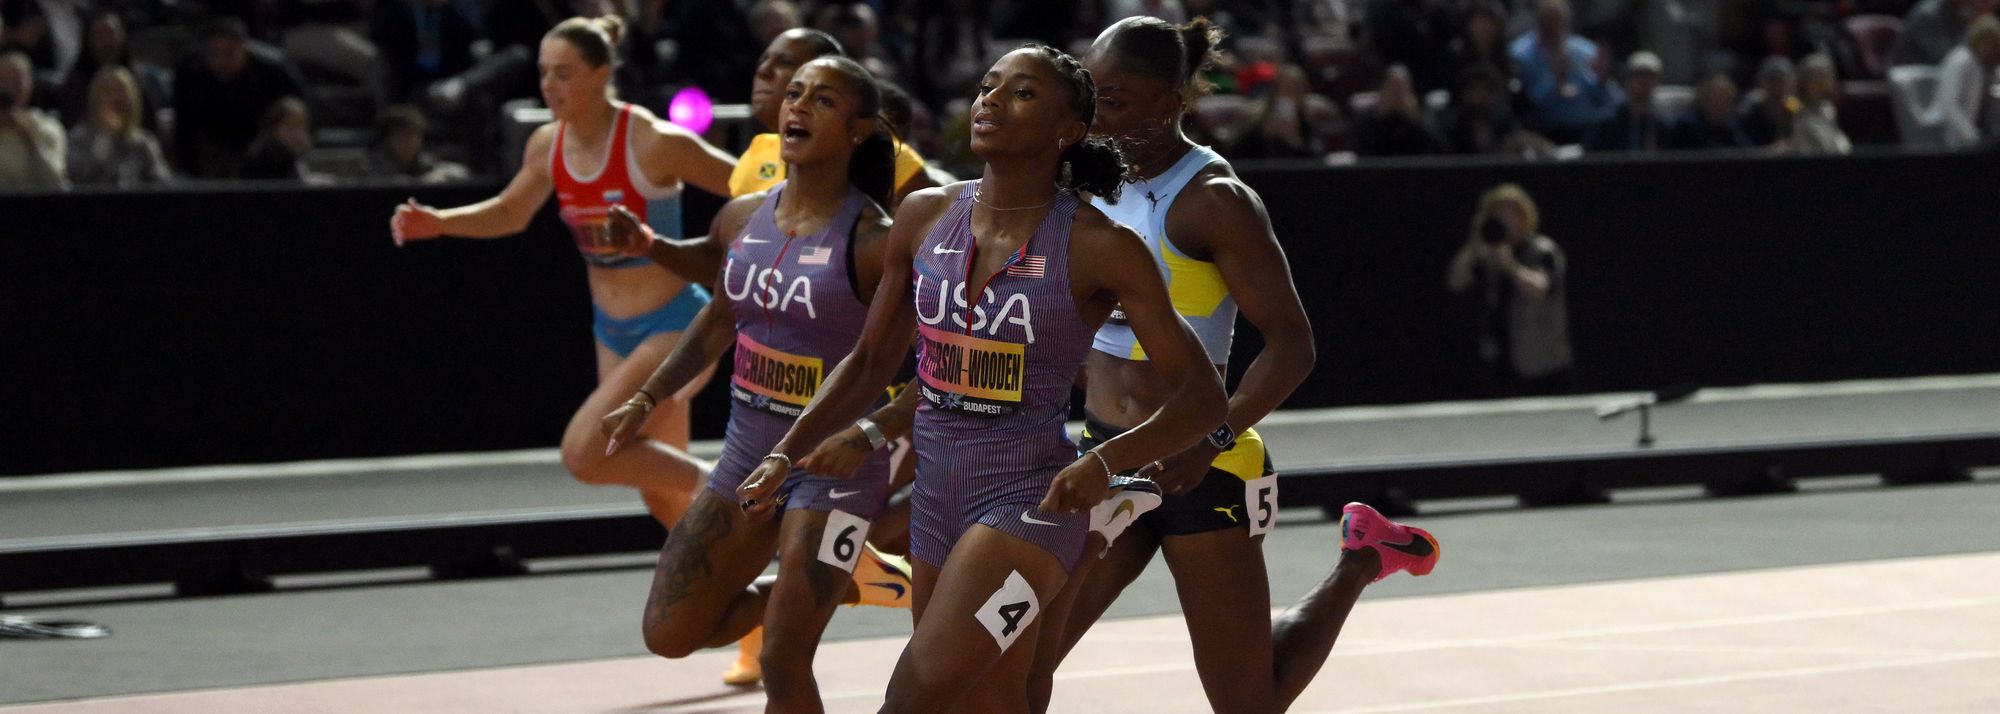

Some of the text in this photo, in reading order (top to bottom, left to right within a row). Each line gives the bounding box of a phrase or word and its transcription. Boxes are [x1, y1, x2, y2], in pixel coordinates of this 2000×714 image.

[724, 258, 816, 319] USA
[916, 274, 1035, 344] USA
[736, 343, 818, 398] RICHARDSON
[769, 402, 801, 417] BUDAPEST
[963, 401, 1001, 414] BUDAPEST
[1258, 487, 1272, 528] 5
[833, 525, 858, 563] 6
[998, 600, 1031, 638] 4
